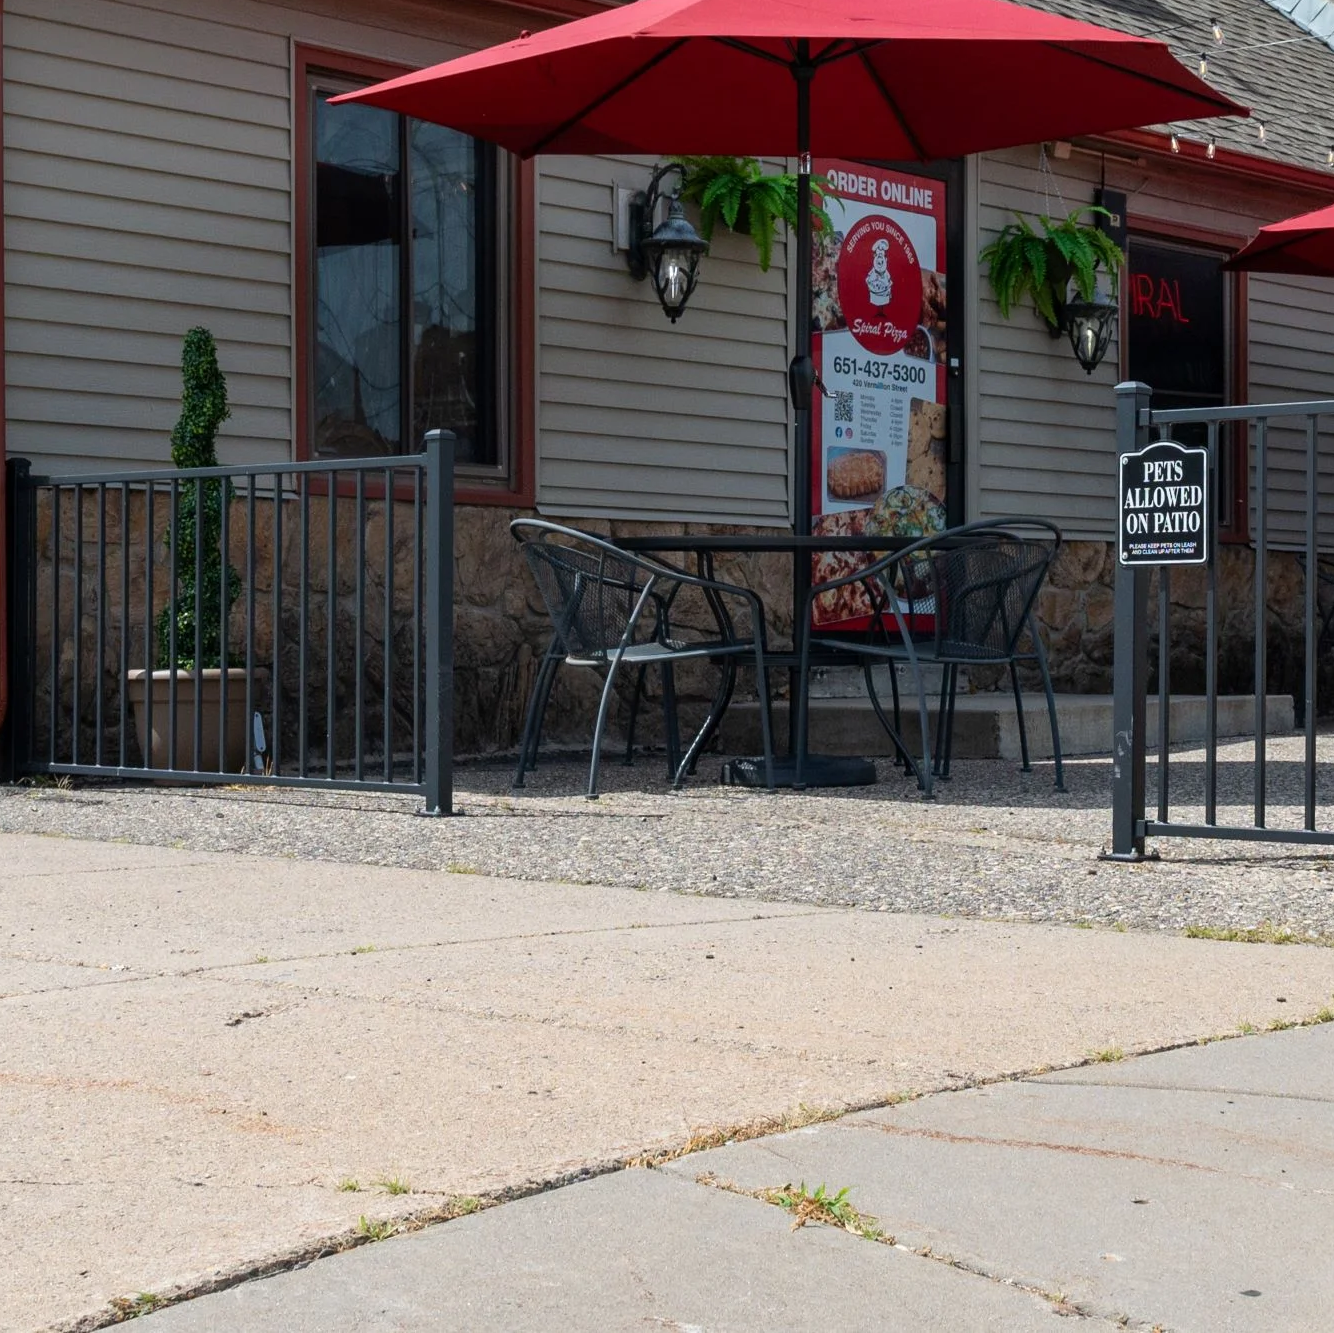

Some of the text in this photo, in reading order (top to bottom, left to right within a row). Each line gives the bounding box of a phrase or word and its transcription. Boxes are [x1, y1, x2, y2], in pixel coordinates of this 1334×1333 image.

[826, 169, 933, 210] ORDER ONLINE
[847, 221, 915, 264] SERVING YOU SINCE 1965
[852, 318, 908, 343] Spiral Pizza
[833, 355, 926, 384] 651-437-5300
[853, 379, 862, 387] 420
[892, 384, 907, 393] Street
[1143, 460, 1183, 482] PETS
[1124, 486, 1202, 508] ALLOWED
[1126, 511, 1200, 534] ON PATIO
